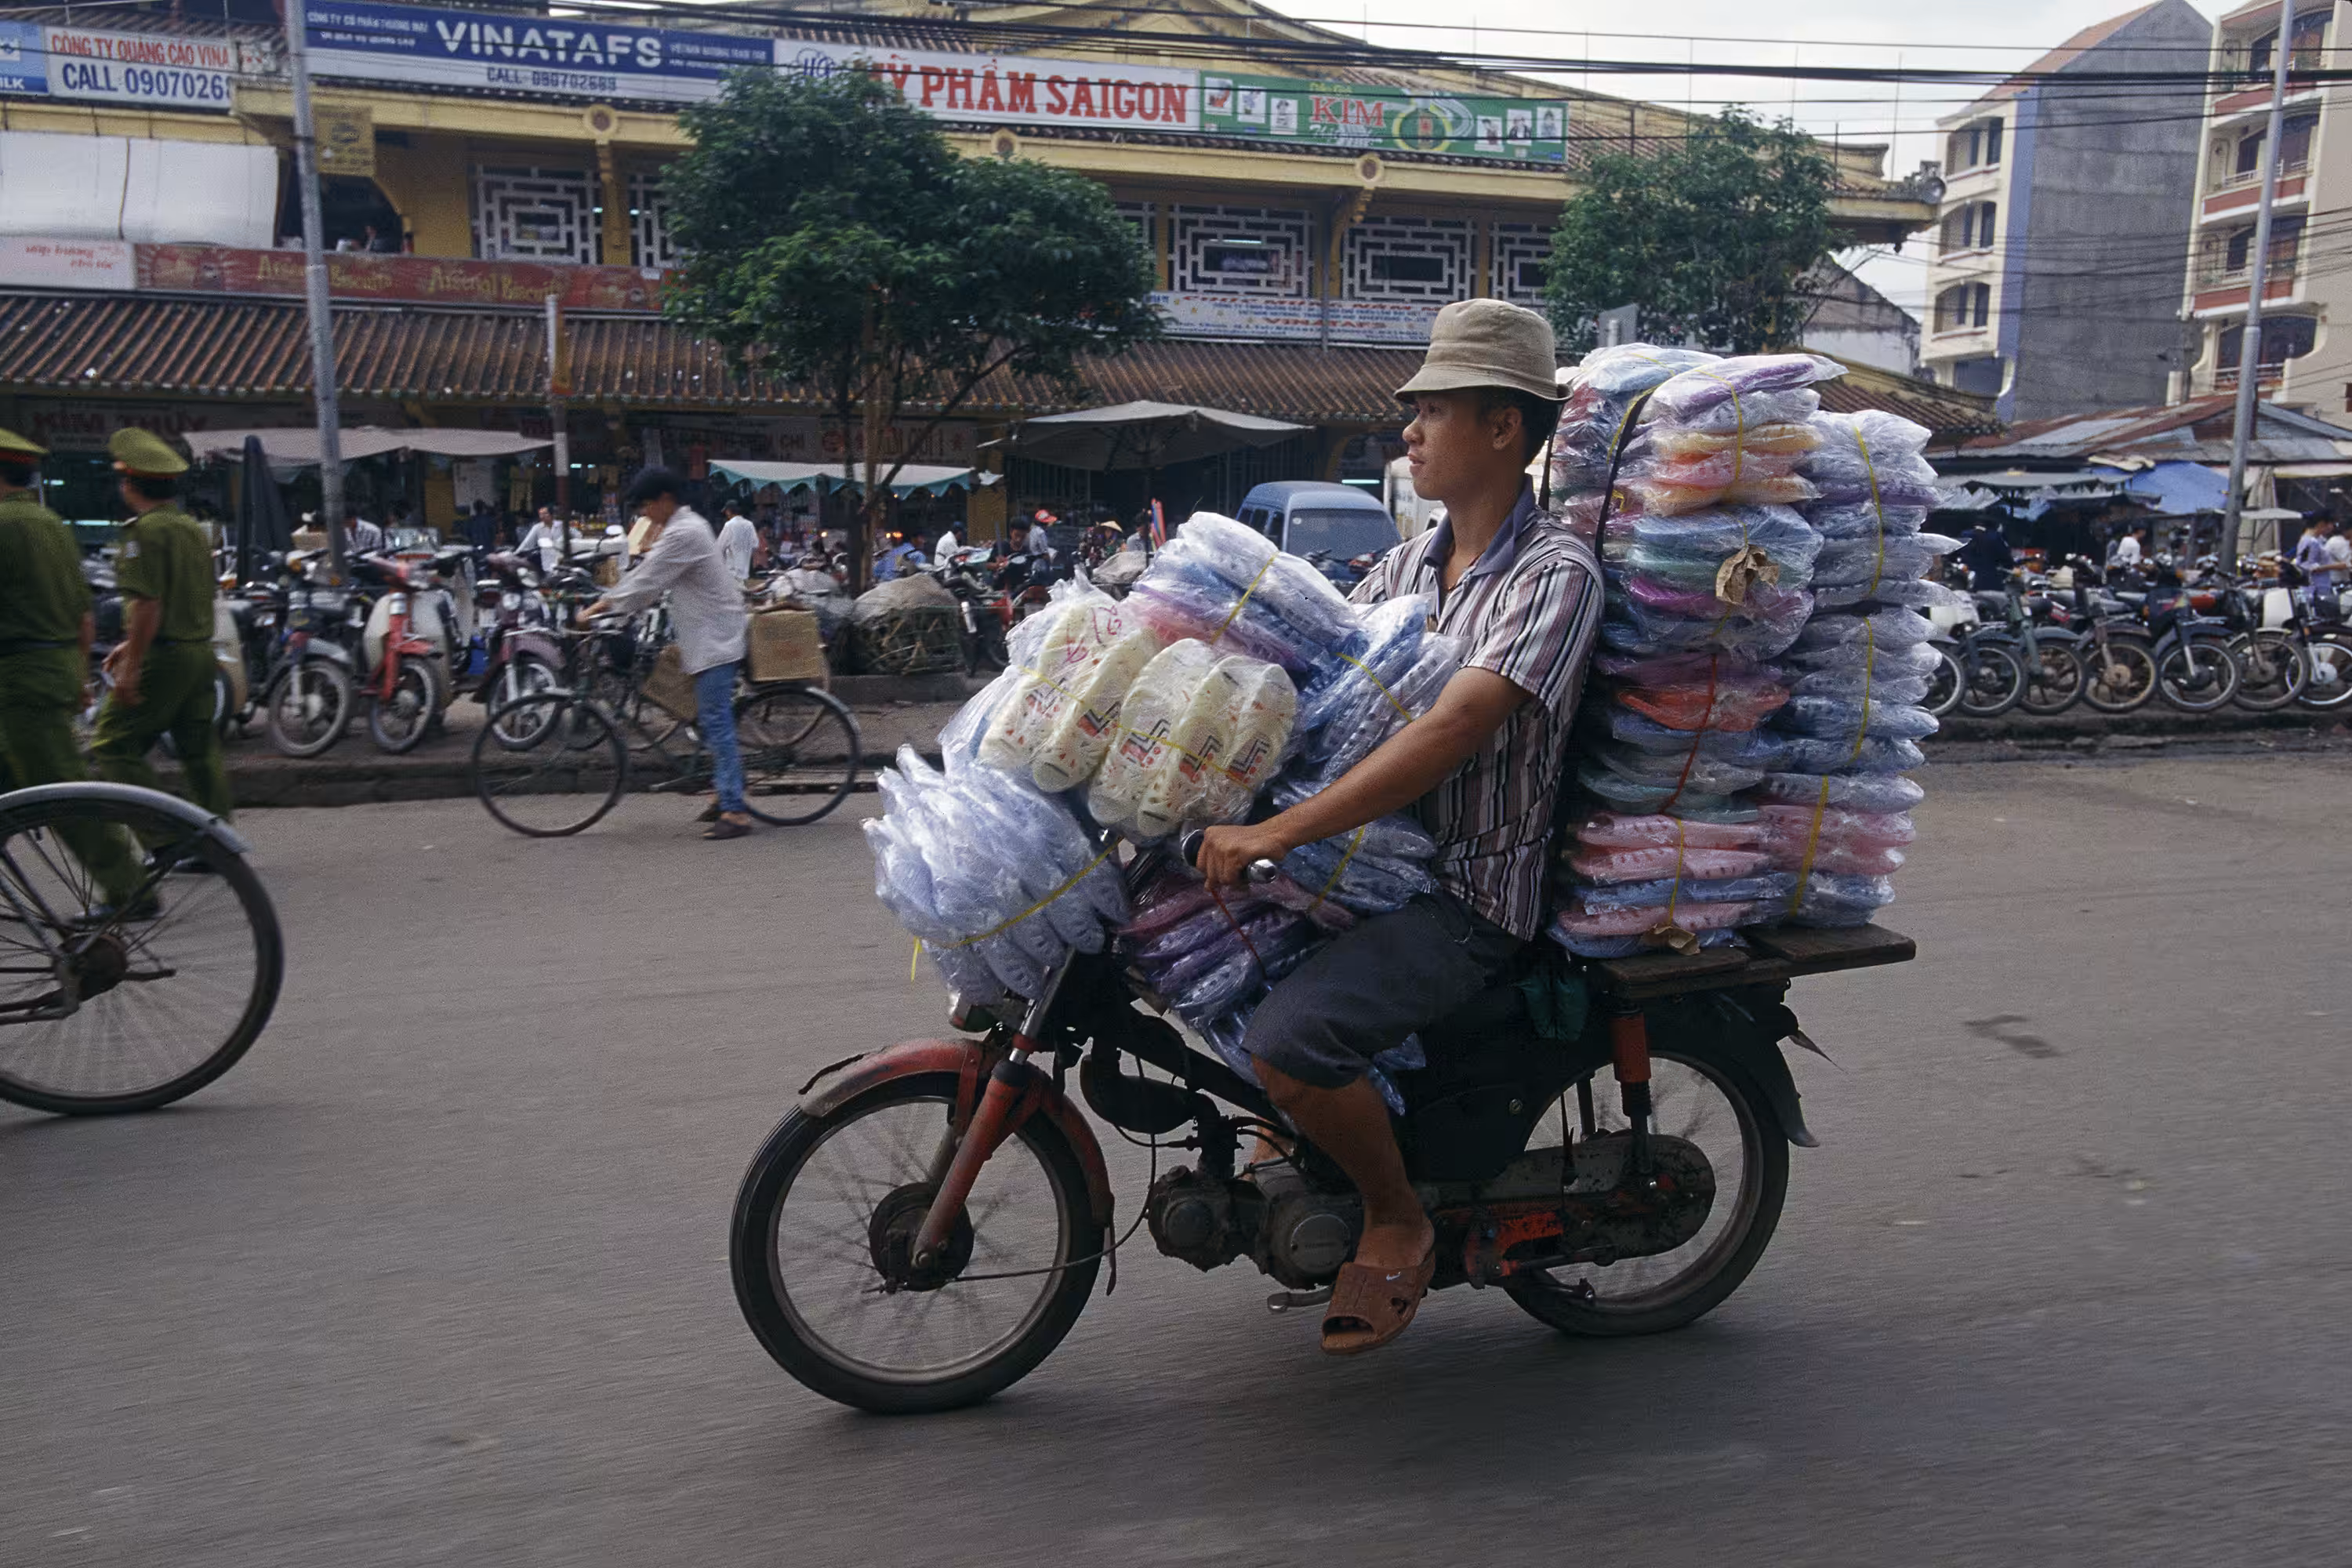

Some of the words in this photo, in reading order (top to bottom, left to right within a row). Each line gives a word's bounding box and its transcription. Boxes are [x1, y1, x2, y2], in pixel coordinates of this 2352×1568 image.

[95, 38, 113, 57] TY
[436, 20, 662, 68] VINATAFS
[63, 64, 117, 93] CALL
[125, 67, 230, 100] 0907026
[487, 67, 521, 84] CALL
[920, 58, 1037, 113] PHẨM
[1046, 74, 1194, 123] SAIGON
[1309, 95, 1386, 128] KIM
